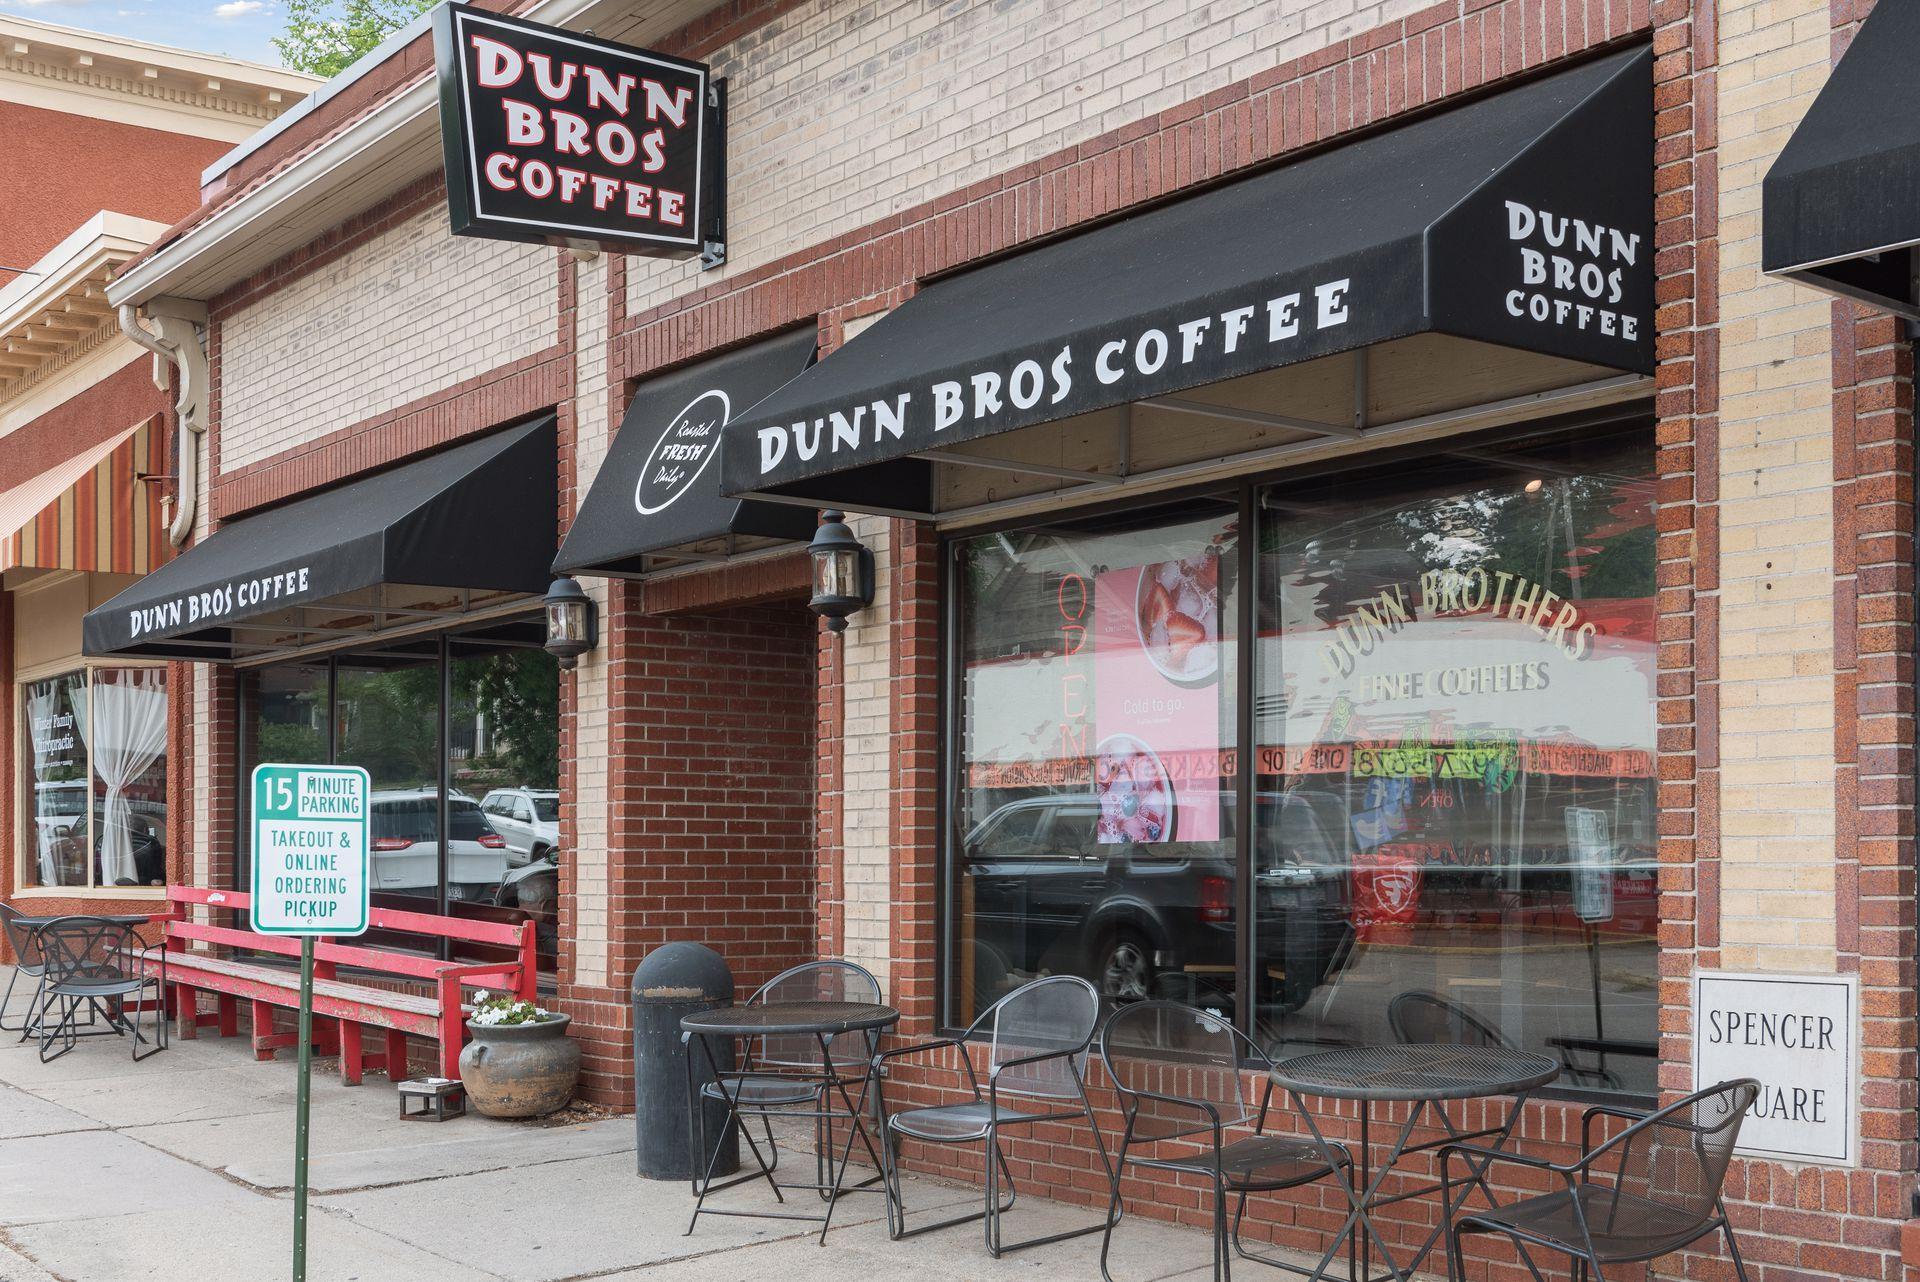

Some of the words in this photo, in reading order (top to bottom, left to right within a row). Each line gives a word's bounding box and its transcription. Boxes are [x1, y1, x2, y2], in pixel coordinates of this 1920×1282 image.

[471, 34, 692, 128] DUNN
[502, 98, 666, 173] BROS
[485, 152, 685, 226] COFFEE
[1505, 200, 1640, 266] DUNN
[1520, 247, 1622, 304] BROS
[1506, 289, 1638, 341] COFFEE
[757, 392, 911, 475] DUNN
[931, 345, 1072, 432] BROS
[1095, 278, 1350, 385] COFFEE
[675, 420, 716, 438] Roasted
[659, 443, 707, 461] FRESH
[130, 599, 182, 639] DUNN
[188, 583, 232, 624] BROS
[237, 567, 309, 608] COFFEE
[1317, 584, 1411, 677] DUNN
[1420, 566, 1597, 662] BROTHERS
[1359, 671, 1410, 700] FINE
[1424, 661, 1541, 697] COFFEES
[52, 711, 73, 730] Family
[1123, 698, 1149, 715] Cold
[1152, 697, 1164, 712] to
[264, 776, 293, 811] 15
[301, 795, 359, 814] PARKING
[307, 777, 356, 795] MINUTE
[271, 830, 333, 848] TAKEOUT
[339, 831, 351, 849] &
[285, 853, 337, 871] ONLINE
[275, 876, 347, 895] ORDERING
[285, 900, 337, 918] PICKUP
[1709, 1009, 1836, 1051] SPENCER
